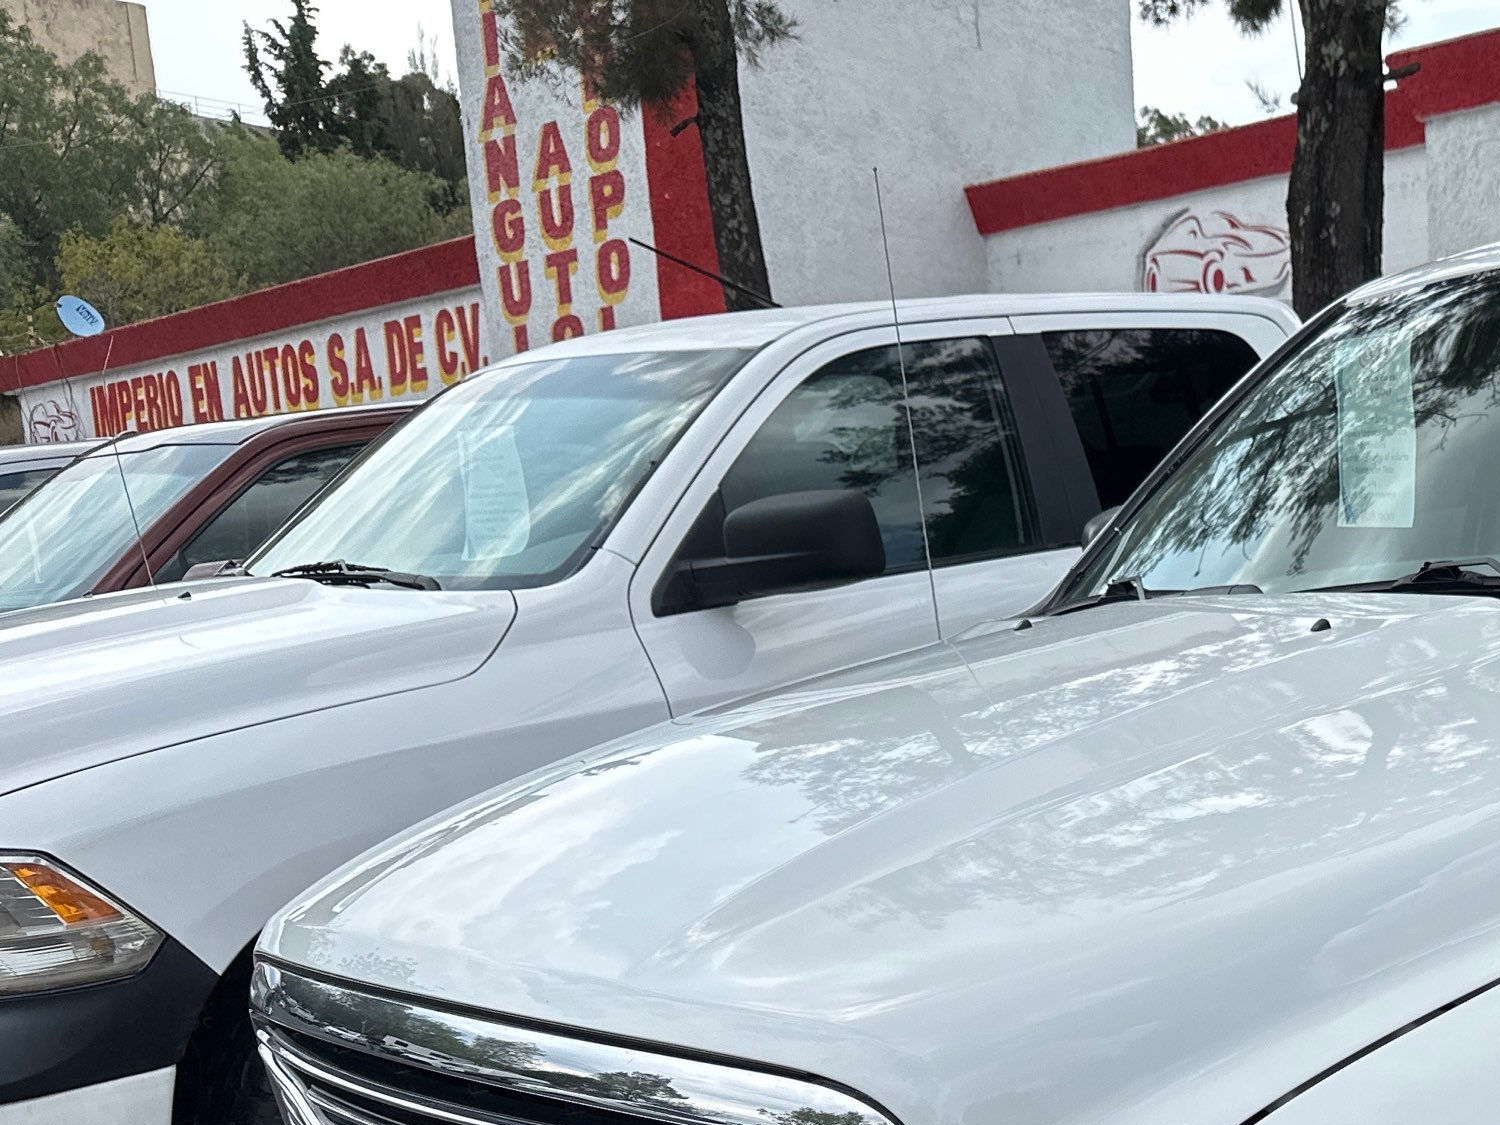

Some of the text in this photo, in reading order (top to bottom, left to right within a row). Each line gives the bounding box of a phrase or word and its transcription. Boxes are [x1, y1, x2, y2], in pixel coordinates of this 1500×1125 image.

[477, 0, 532, 353] IANGU
[89, 302, 489, 438] IMPERIO EN AUTOS S.A. DE C.V.
